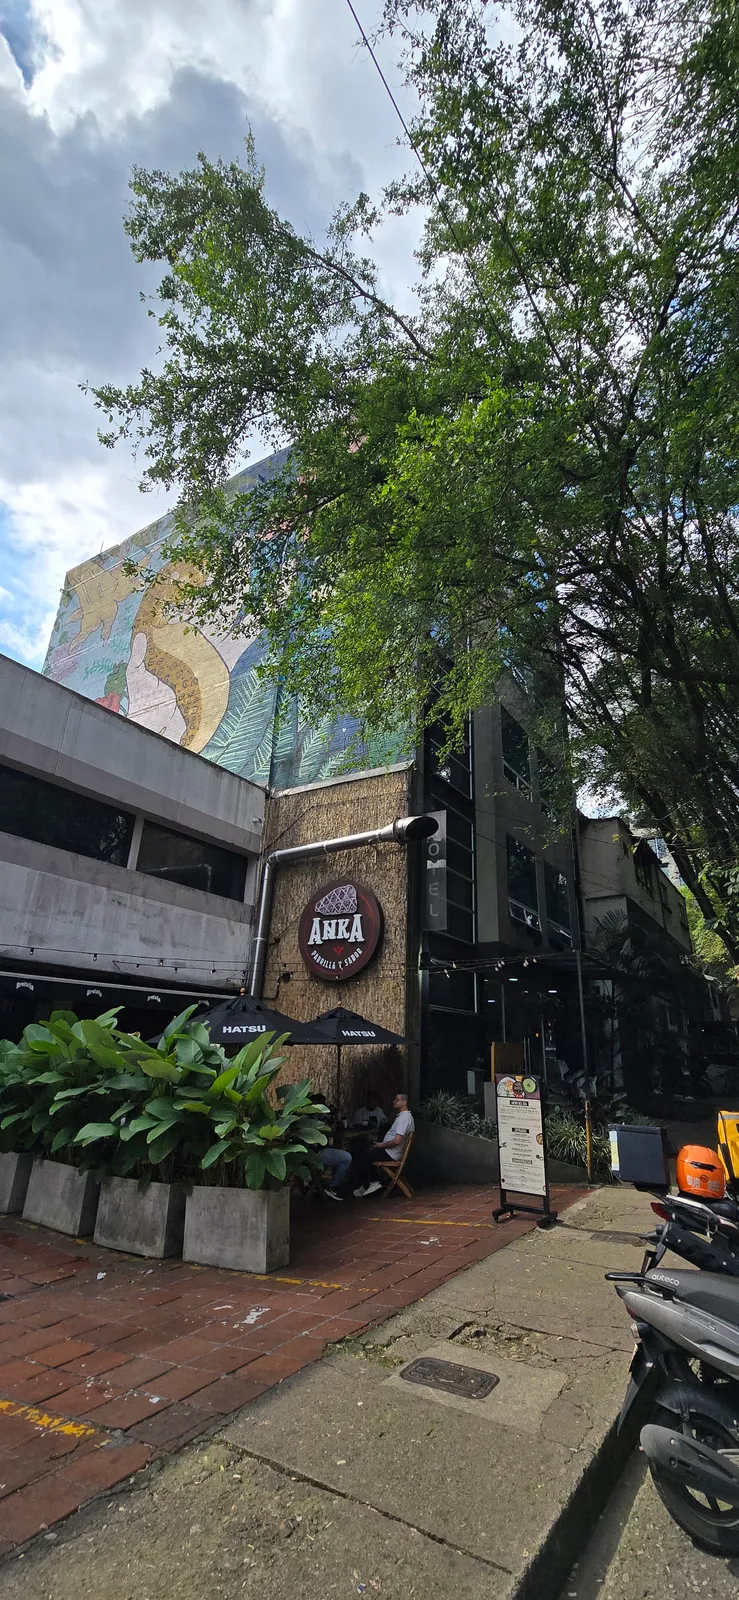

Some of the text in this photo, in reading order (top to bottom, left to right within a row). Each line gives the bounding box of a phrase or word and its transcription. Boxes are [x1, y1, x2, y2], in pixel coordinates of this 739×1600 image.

[307, 913, 365, 945] ANKA
[310, 949, 336, 970] PARRILLA
[343, 947, 363, 967] SABOR
[222, 1024, 267, 1033] HATSU
[341, 1029, 377, 1038] HATSU
[651, 1273, 680, 1287] auteco
